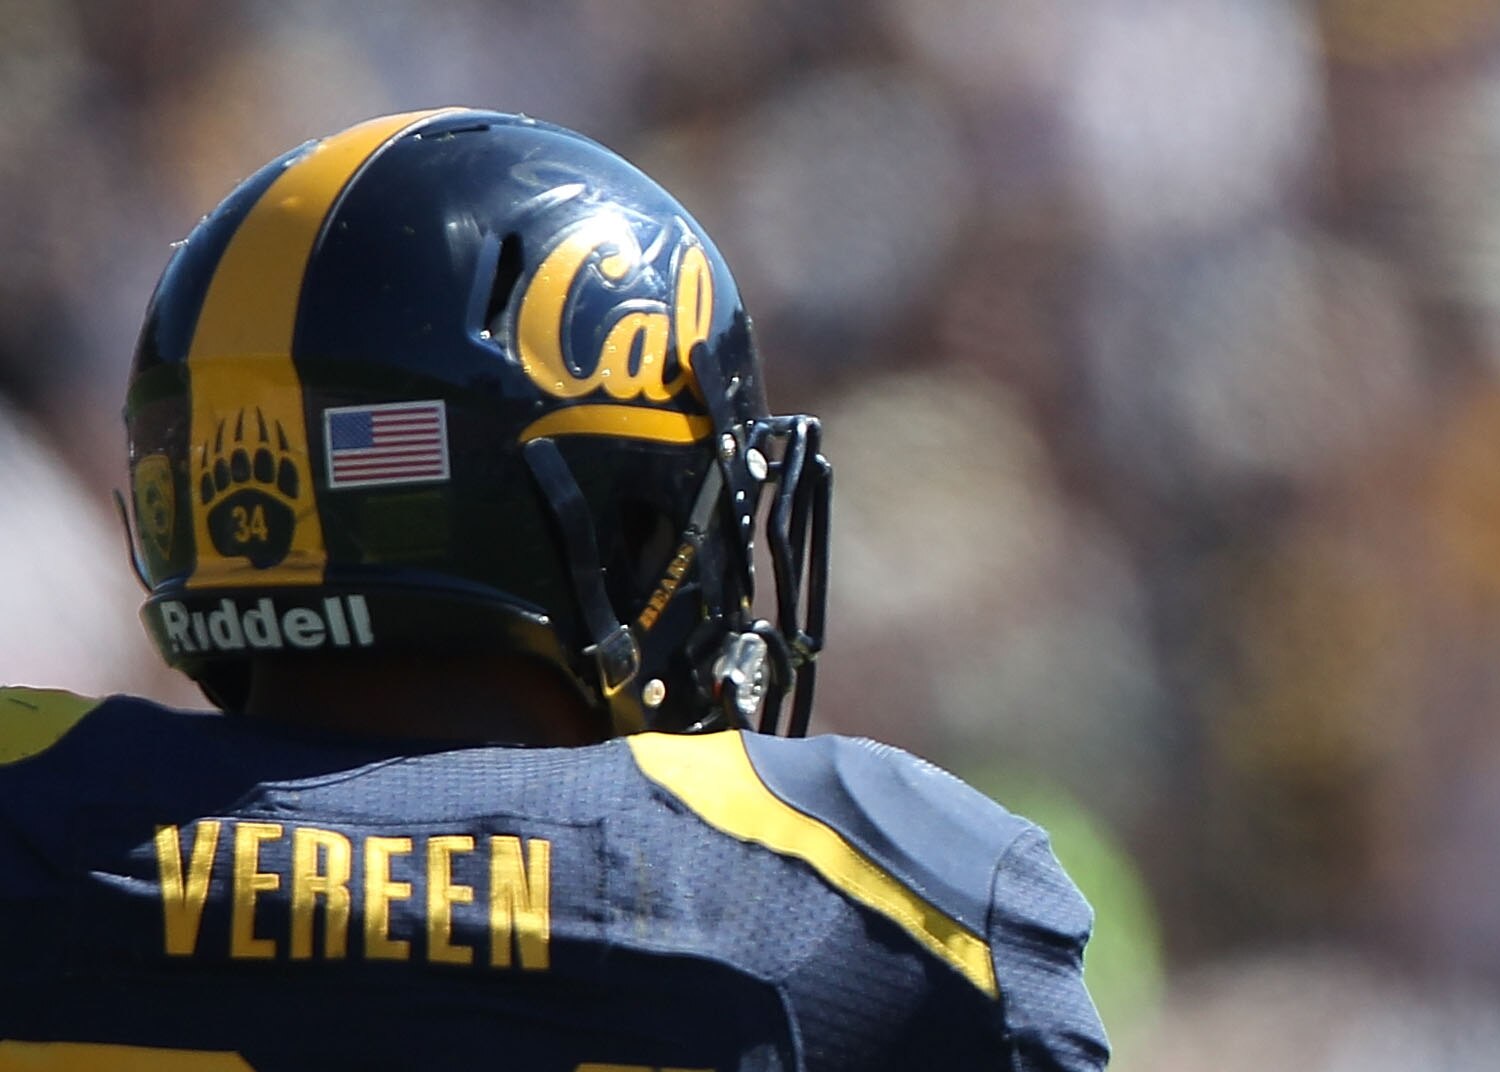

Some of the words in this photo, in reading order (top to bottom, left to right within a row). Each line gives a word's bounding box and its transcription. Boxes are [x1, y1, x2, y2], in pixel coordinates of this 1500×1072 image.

[517, 209, 714, 402] Cal
[231, 504, 269, 543] 34
[160, 593, 374, 653] Riddell
[154, 819, 552, 971] VEREEN
